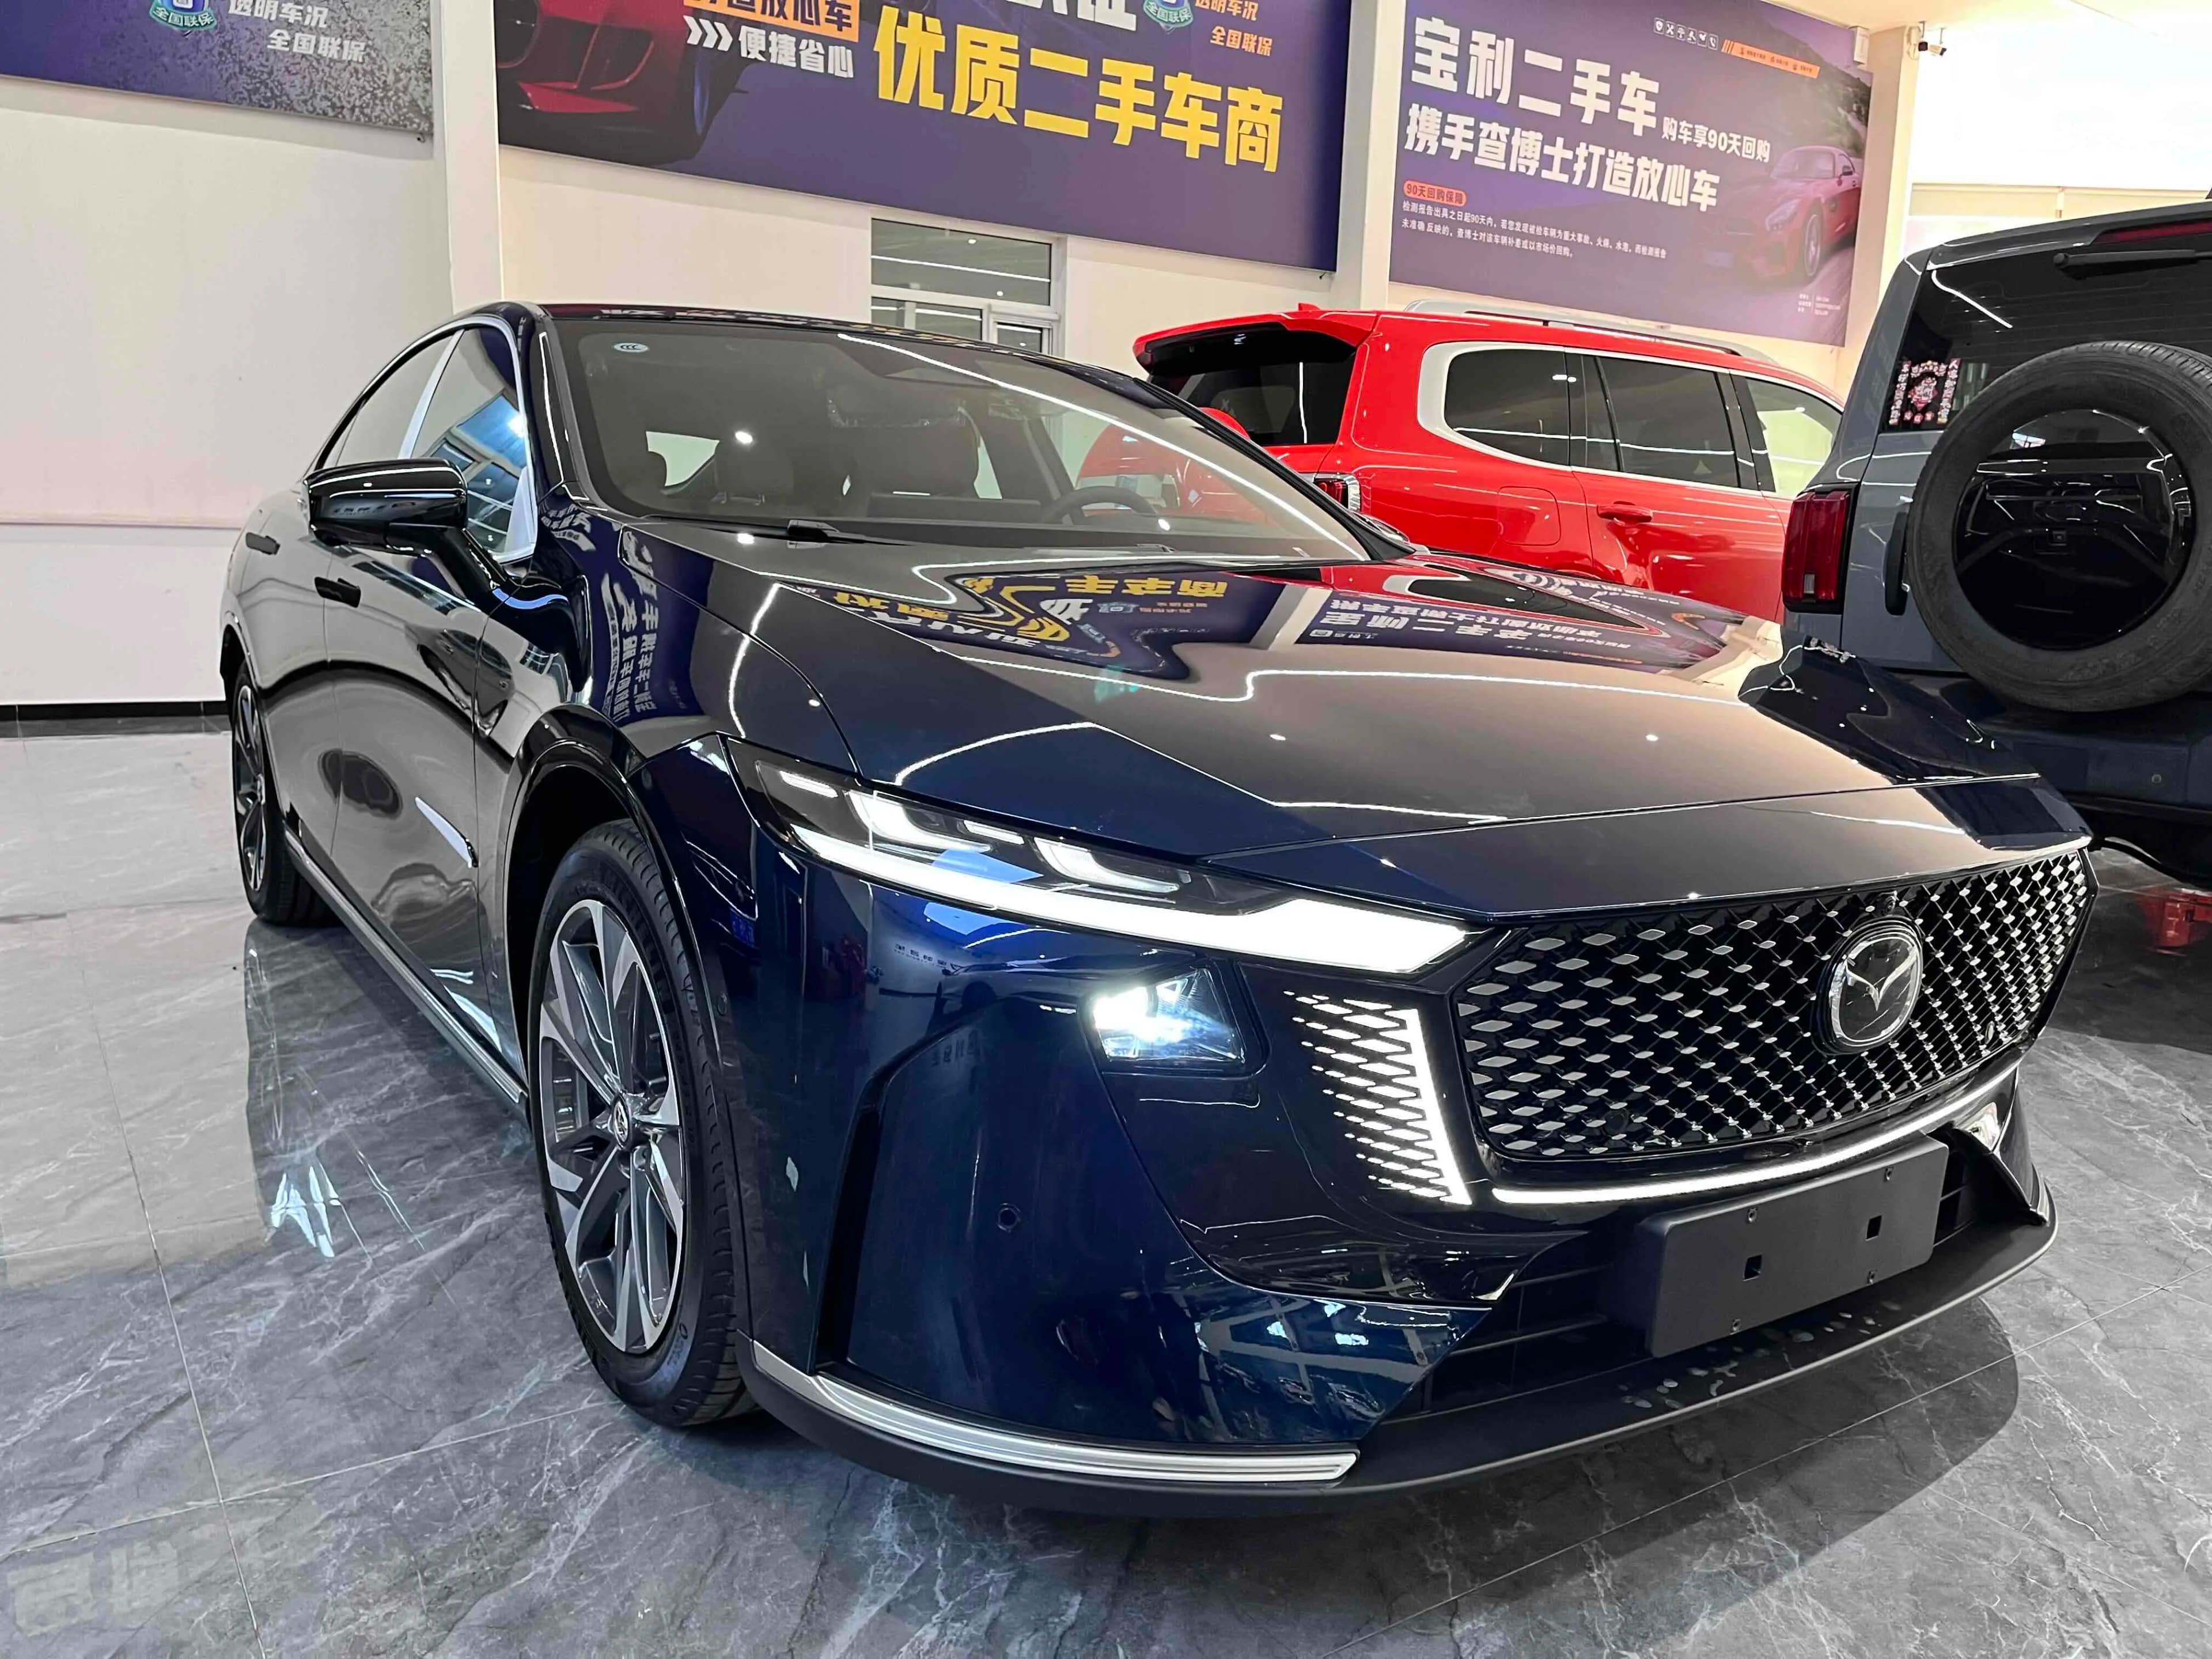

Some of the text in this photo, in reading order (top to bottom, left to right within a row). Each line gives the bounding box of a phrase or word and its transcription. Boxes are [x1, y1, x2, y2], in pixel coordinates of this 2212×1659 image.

[153, 6, 214, 26] 全国联保
[692, 0, 852, 32] 放心车
[1145, 2, 1191, 23] 全国联保
[267, 29, 367, 62] 全国联保
[738, 25, 854, 78] 便捷省心
[1210, 25, 1272, 56] 全国联保
[873, 6, 1283, 172] 优质二手车商
[1411, 17, 1660, 137] 宝利二手车
[1662, 116, 1771, 164] 购车享90天回购
[1404, 103, 1721, 213] 携手查博士打造放心车
[1407, 183, 1464, 204] 90天回购保障
